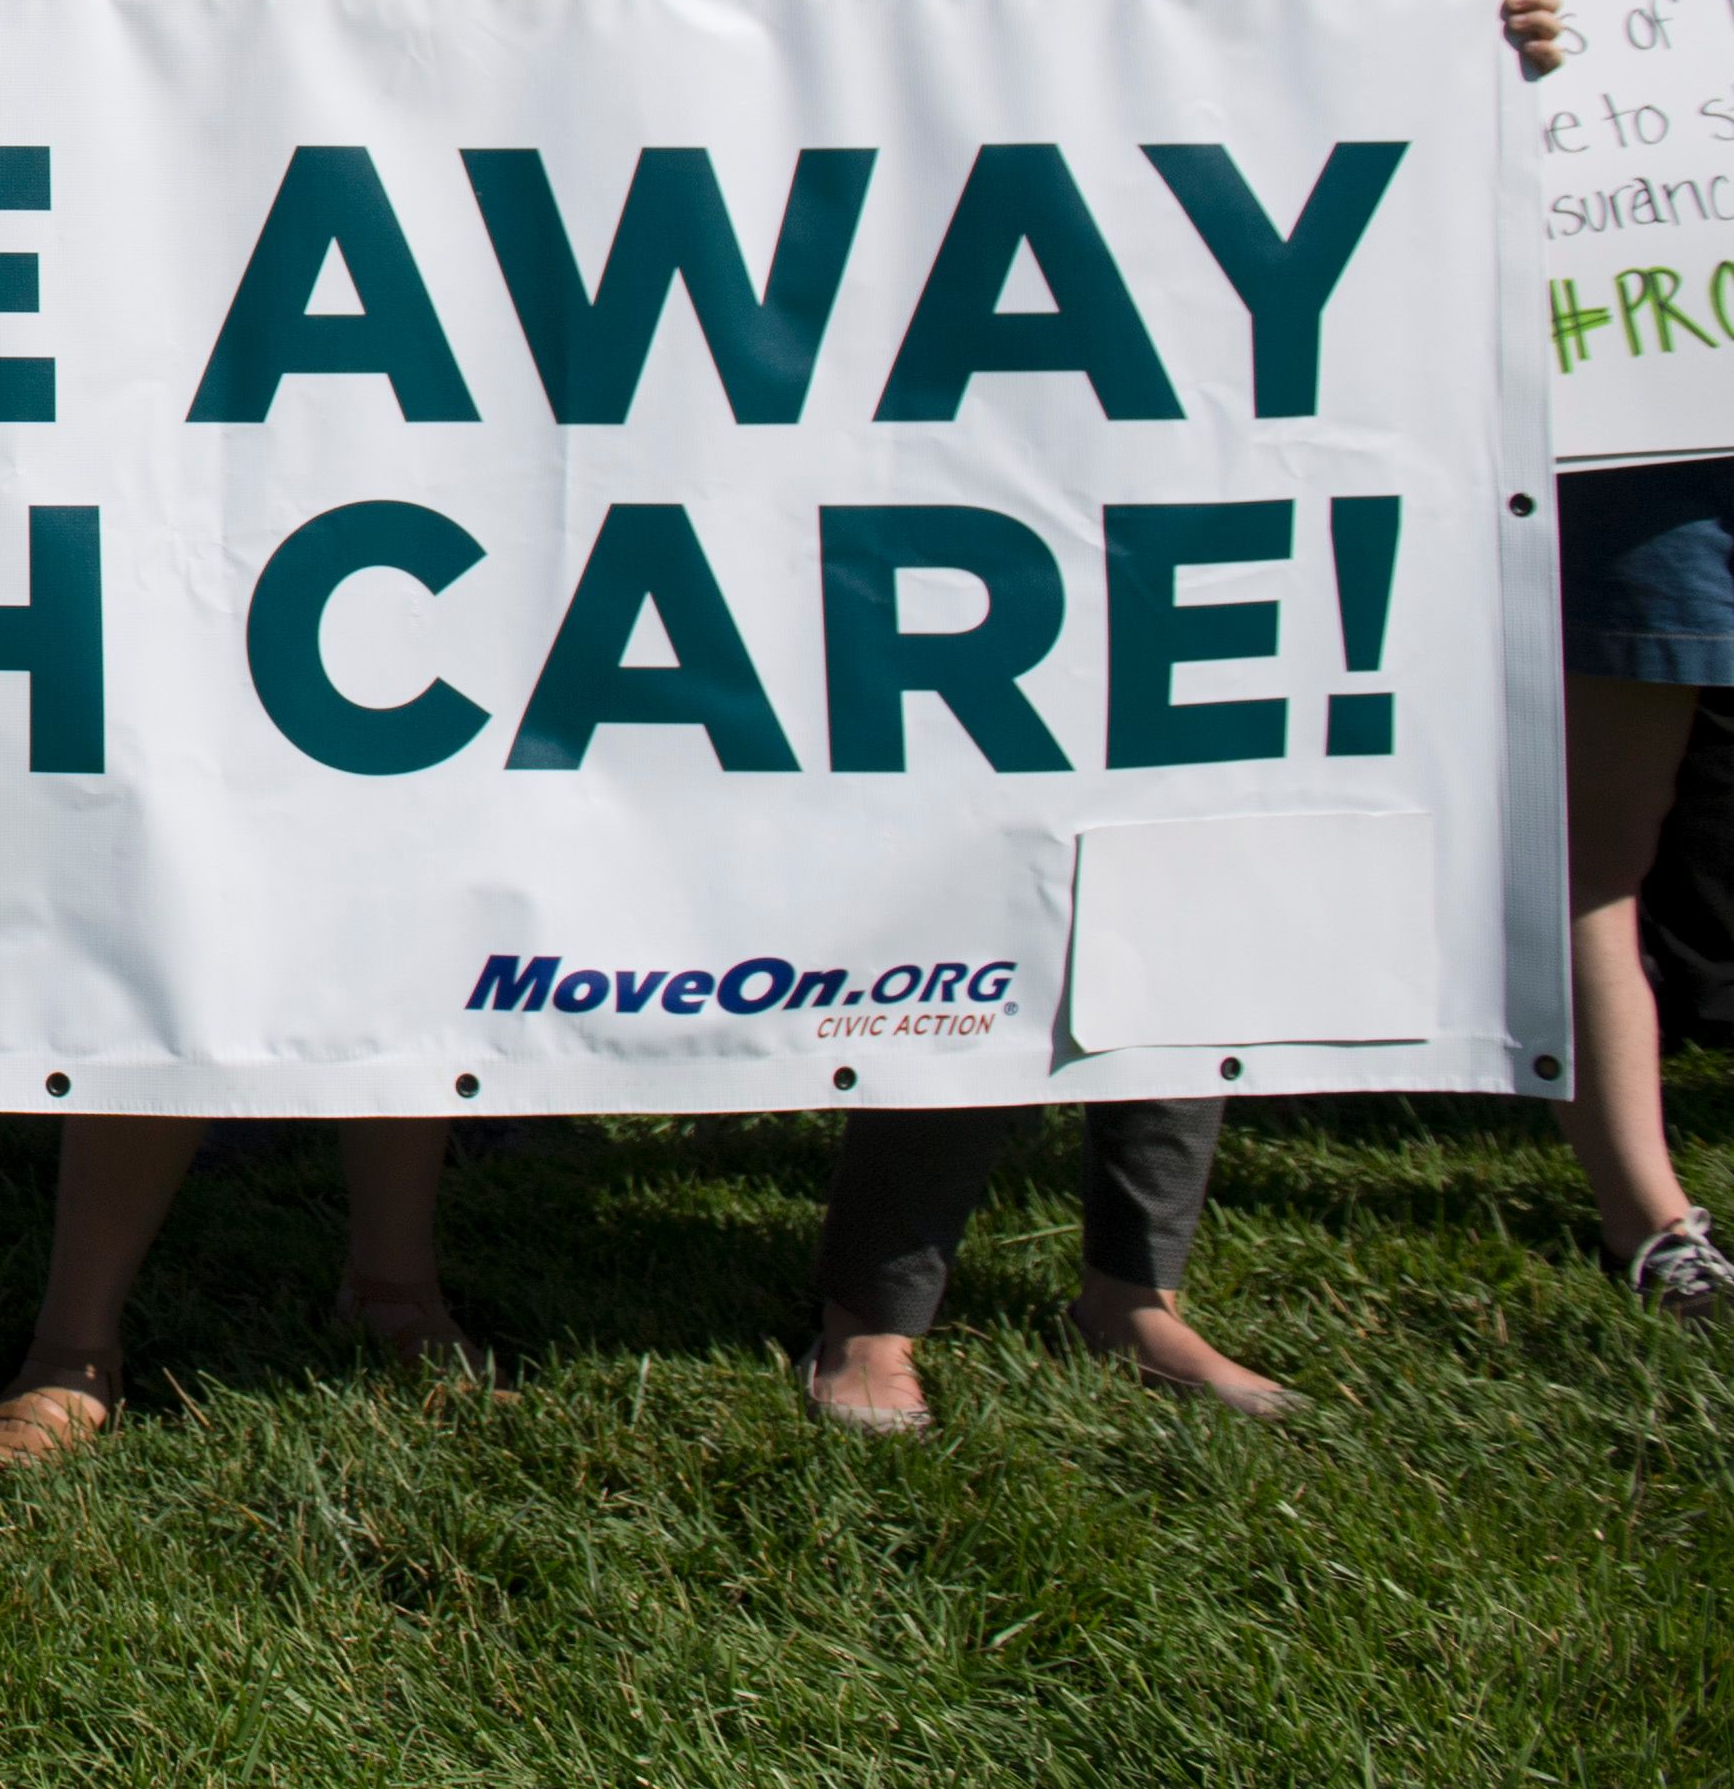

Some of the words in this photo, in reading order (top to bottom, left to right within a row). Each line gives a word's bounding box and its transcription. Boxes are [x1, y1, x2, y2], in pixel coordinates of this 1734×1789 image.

[1602, 93, 1669, 148] to
[186, 142, 1408, 424] AWAY
[247, 496, 1399, 775] CARE!
[817, 1014, 887, 1039] CIVIC
[893, 1012, 996, 1036] ACTION
